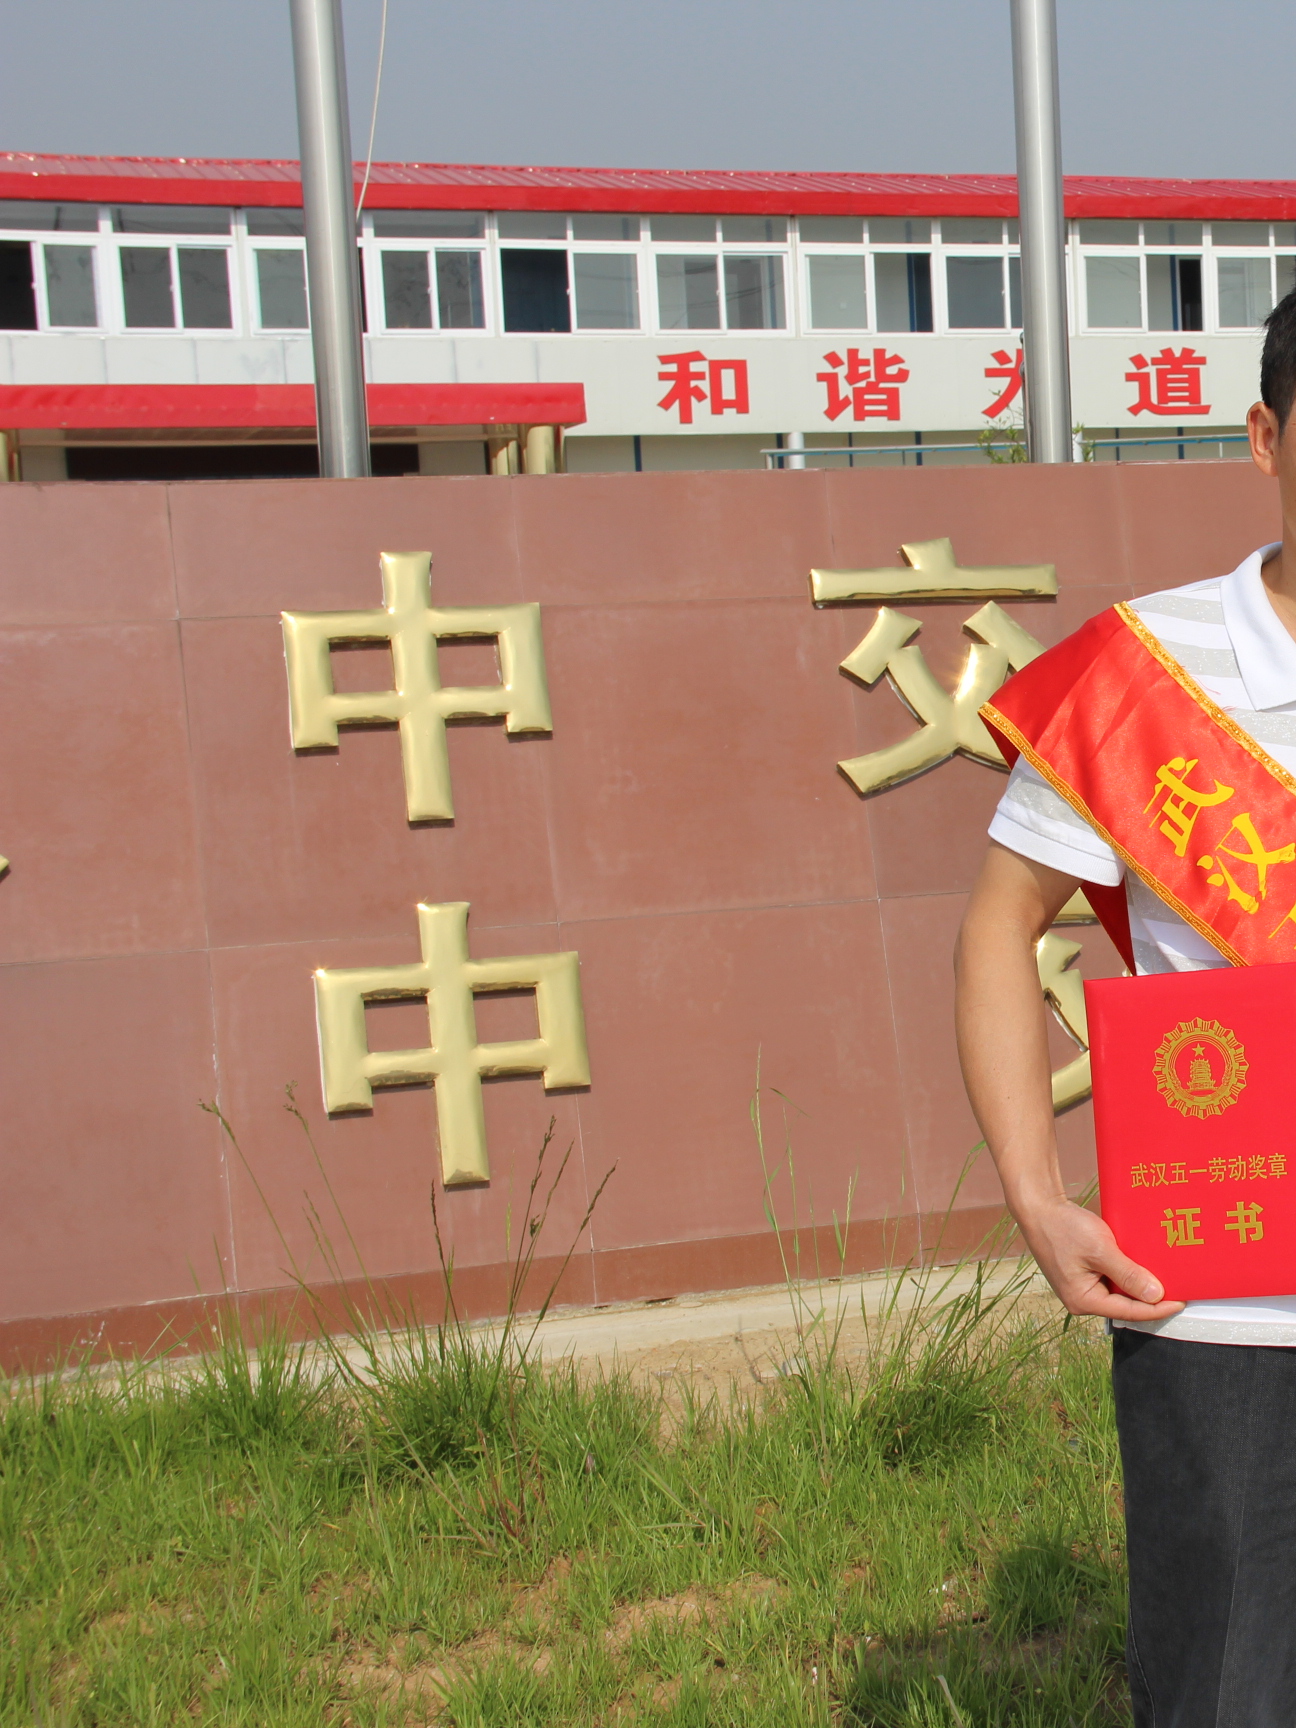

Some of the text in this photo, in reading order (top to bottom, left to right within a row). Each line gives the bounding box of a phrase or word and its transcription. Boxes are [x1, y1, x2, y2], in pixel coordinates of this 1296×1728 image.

[1130, 1152, 1288, 1188] 武汉五一劳动奖章
[1160, 1201, 1264, 1248] 证书
